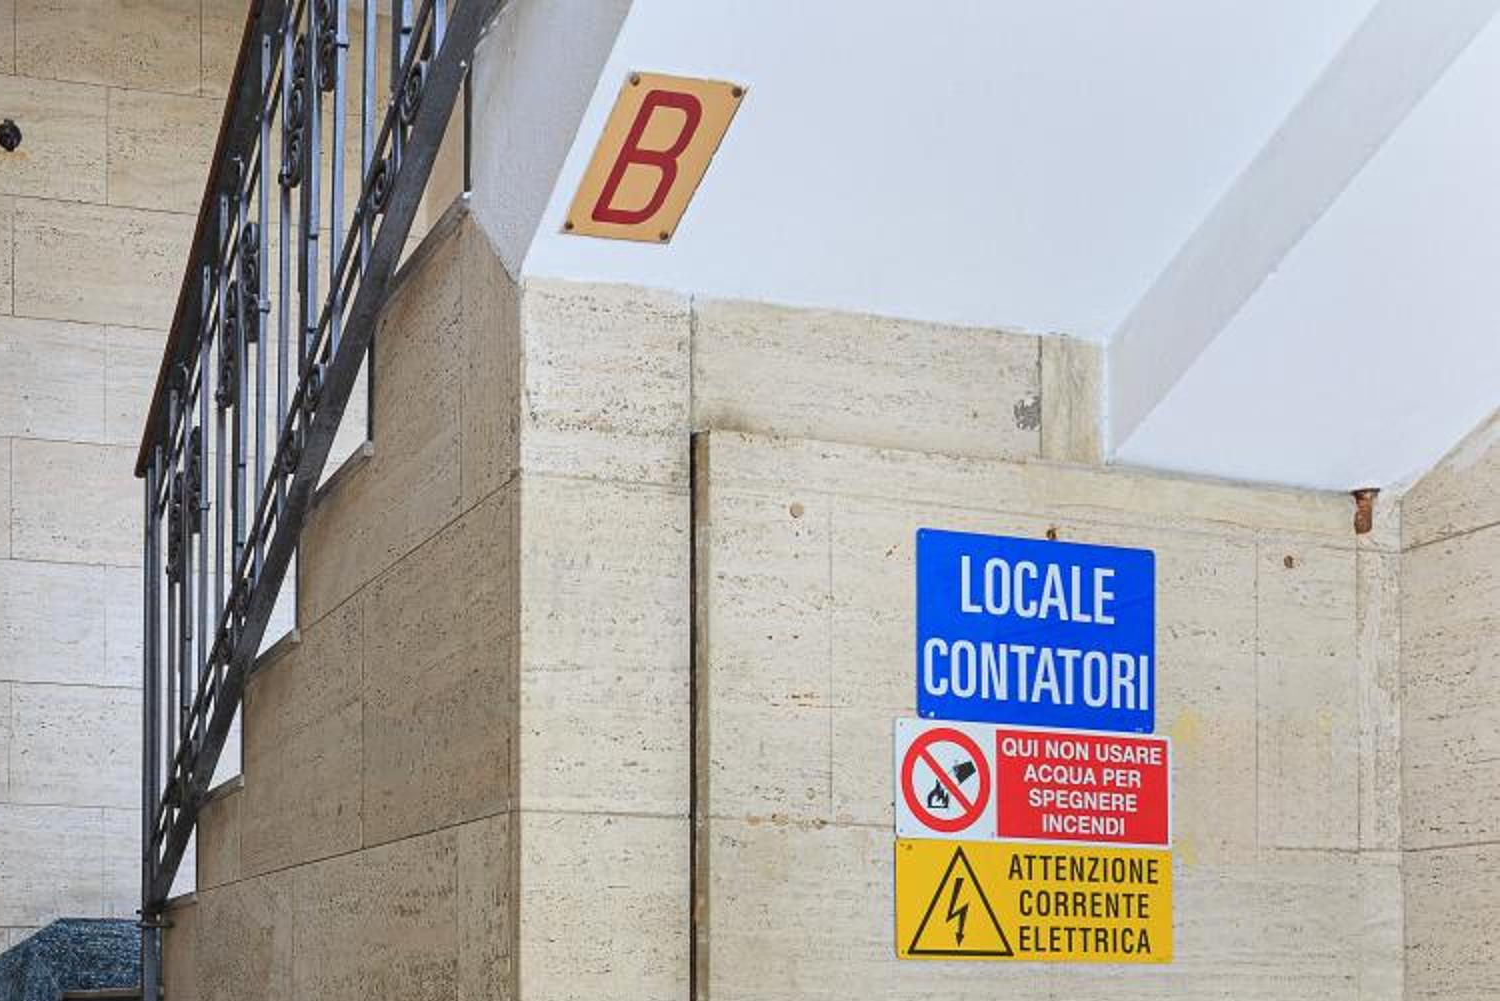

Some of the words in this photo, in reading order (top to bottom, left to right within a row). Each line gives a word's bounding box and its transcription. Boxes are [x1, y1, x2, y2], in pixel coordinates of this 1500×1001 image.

[591, 89, 703, 225] B
[961, 555, 1115, 624] LOCALE
[924, 638, 1148, 710] CONTATORI
[1002, 737, 1041, 759] QUI
[1046, 741, 1089, 761] NON
[1095, 744, 1162, 765] USARE
[1024, 764, 1097, 786] ACQUA
[1103, 768, 1141, 788] PER
[1029, 789, 1137, 812] SPEGNERE
[1042, 813, 1125, 836] INCENDI
[1008, 854, 1158, 884] ATTENZIONE
[1019, 890, 1149, 919] CORRENTE
[1019, 927, 1151, 953] ELETTRICA
